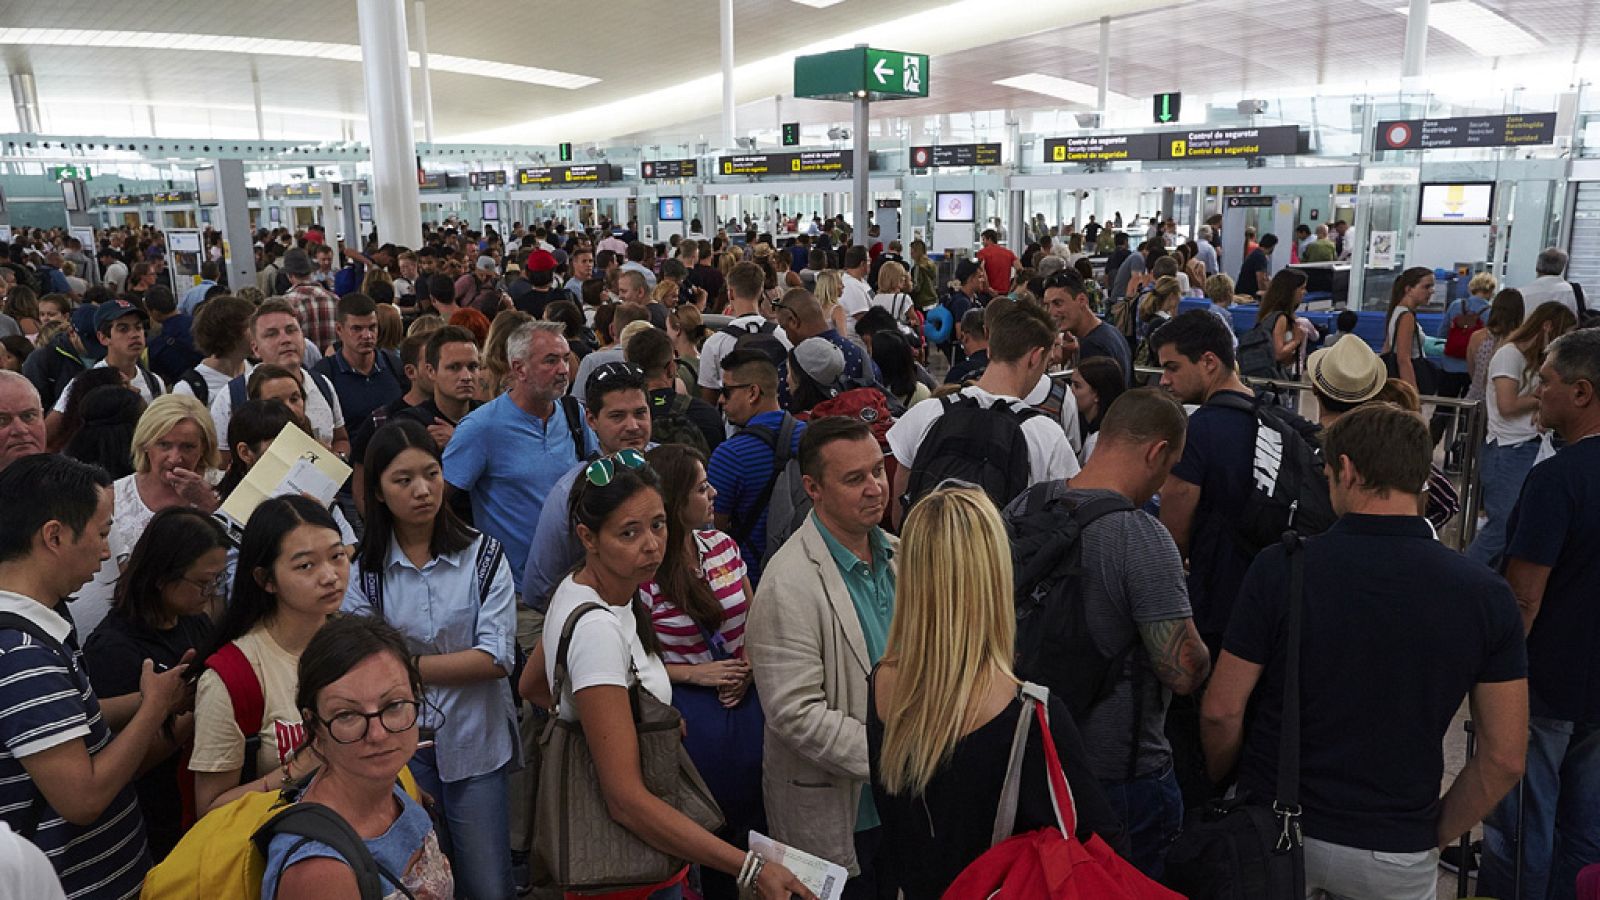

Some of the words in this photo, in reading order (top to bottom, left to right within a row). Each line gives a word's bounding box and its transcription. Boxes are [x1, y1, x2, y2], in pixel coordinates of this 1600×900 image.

[1188, 132, 1213, 140] Control
[1214, 131, 1223, 139] de
[1224, 130, 1258, 139] seguretat
[1067, 138, 1089, 146] Control
[1090, 137, 1098, 145] de
[1067, 152, 1089, 160] Control
[1098, 150, 1128, 160] seguridad
[1188, 147, 1213, 155] Control
[1214, 147, 1223, 155] de
[1224, 145, 1258, 155] seguridad
[1253, 418, 1283, 498] NIKE
[273, 720, 304, 765] PU
